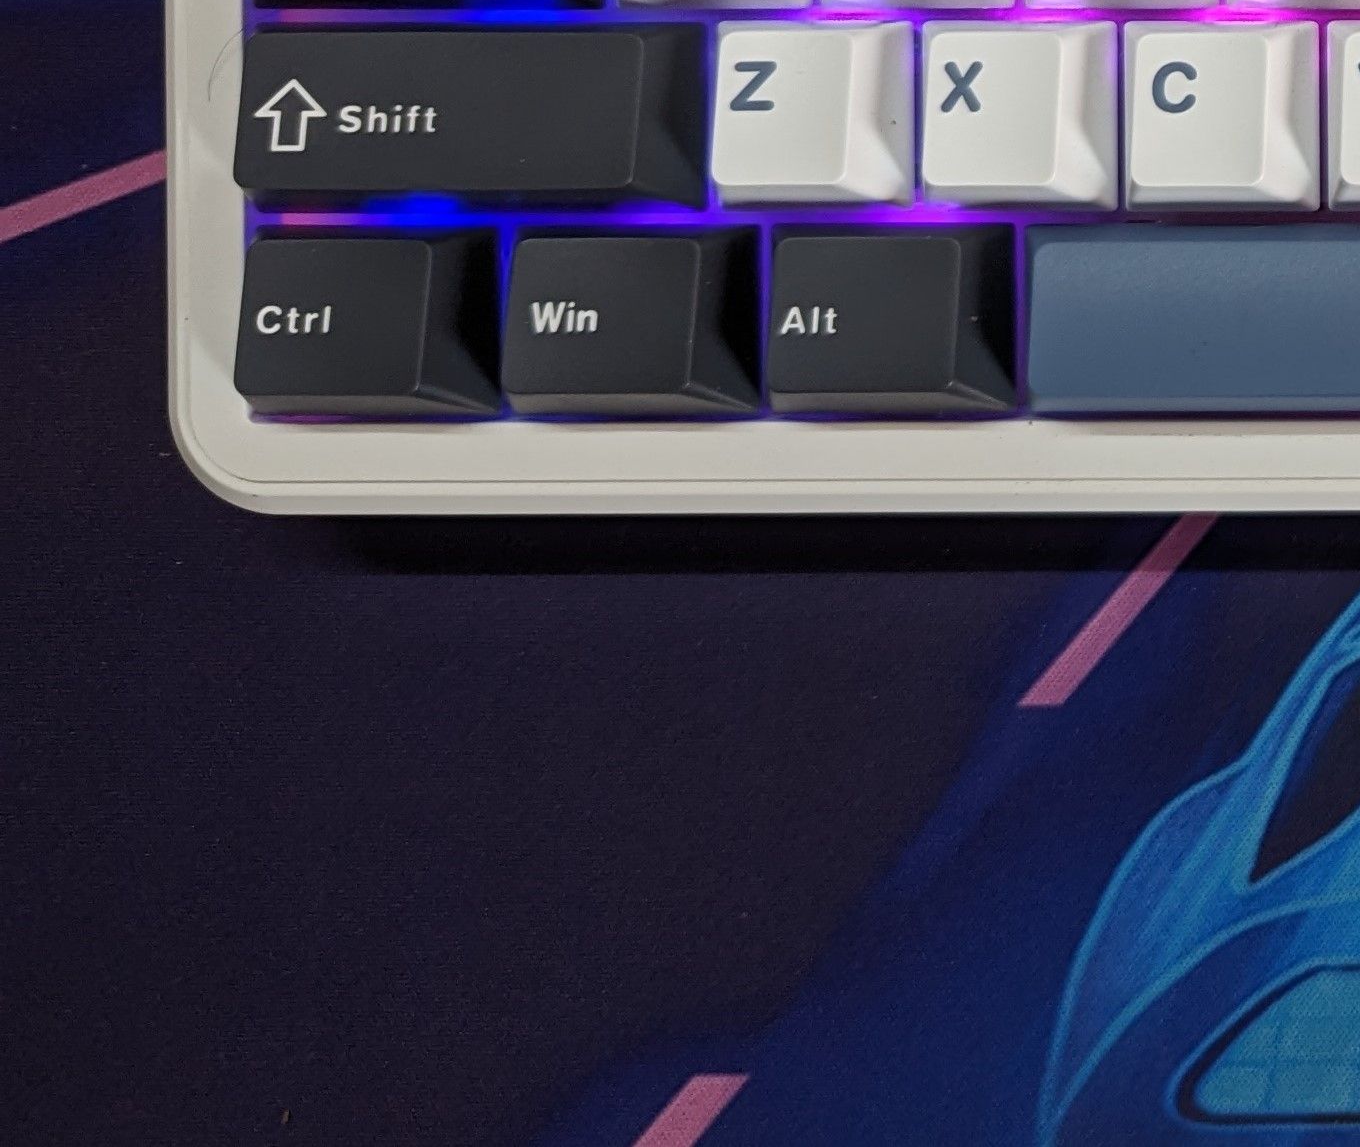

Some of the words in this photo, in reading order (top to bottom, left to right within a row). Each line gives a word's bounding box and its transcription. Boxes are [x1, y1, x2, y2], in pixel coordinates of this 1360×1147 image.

[730, 62, 776, 111] Z
[941, 62, 983, 112] X
[1152, 62, 1197, 113] C
[339, 105, 436, 132] Shift
[257, 306, 331, 333] Ctrl
[532, 302, 597, 333] Win
[780, 307, 837, 334] Alt
